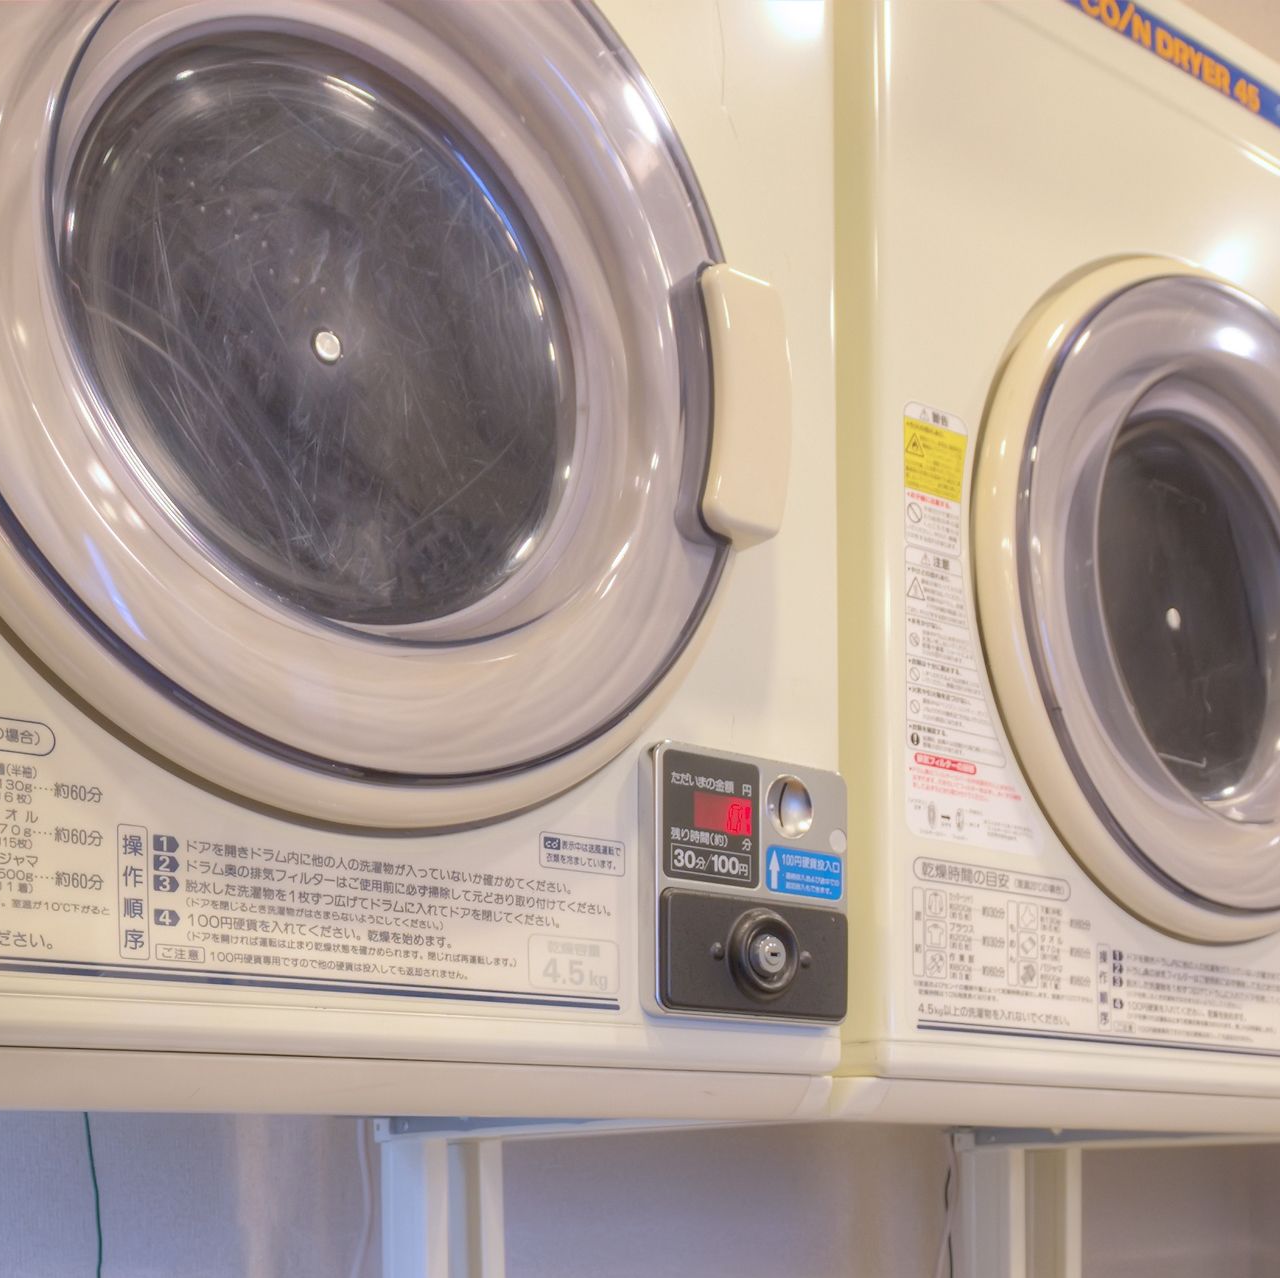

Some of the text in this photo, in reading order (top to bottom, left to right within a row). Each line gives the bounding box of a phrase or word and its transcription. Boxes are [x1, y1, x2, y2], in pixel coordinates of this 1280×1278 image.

[1156, 27, 1231, 95] DRYER
[54, 782, 104, 804] 約60分
[671, 771, 752, 797] ただいまの金額 円
[54, 827, 104, 847] 約60分
[670, 828, 752, 851] 残り時間(約) 分
[186, 839, 572, 895] ドアを開きドラム内に他の人の洗濯物が入っていないか確かめてください。
[546, 853, 616, 870] 衣類を冷ましています。
[673, 848, 749, 877] 30分/100円
[922, 861, 1010, 889] 乾燥時間の目安
[55, 871, 105, 891] 約60分
[122, 834, 145, 951] 操作順序
[186, 860, 612, 917] ドラム奥の排気フィルターはご使用前に必ず掃除して元どおり取り付けてください。
[185, 879, 560, 929] 脱水した洗濯物を1枚ずつ広げてドラムに入れてドアを閉じてください。
[188, 914, 453, 949] 100円硬貨を入れてください。乾燥を始めます。
[161, 947, 469, 981] ご注意 100円硬貨専用ですので他の硬貨は投入しても返却されません。
[543, 957, 609, 990] 4.5 kg
